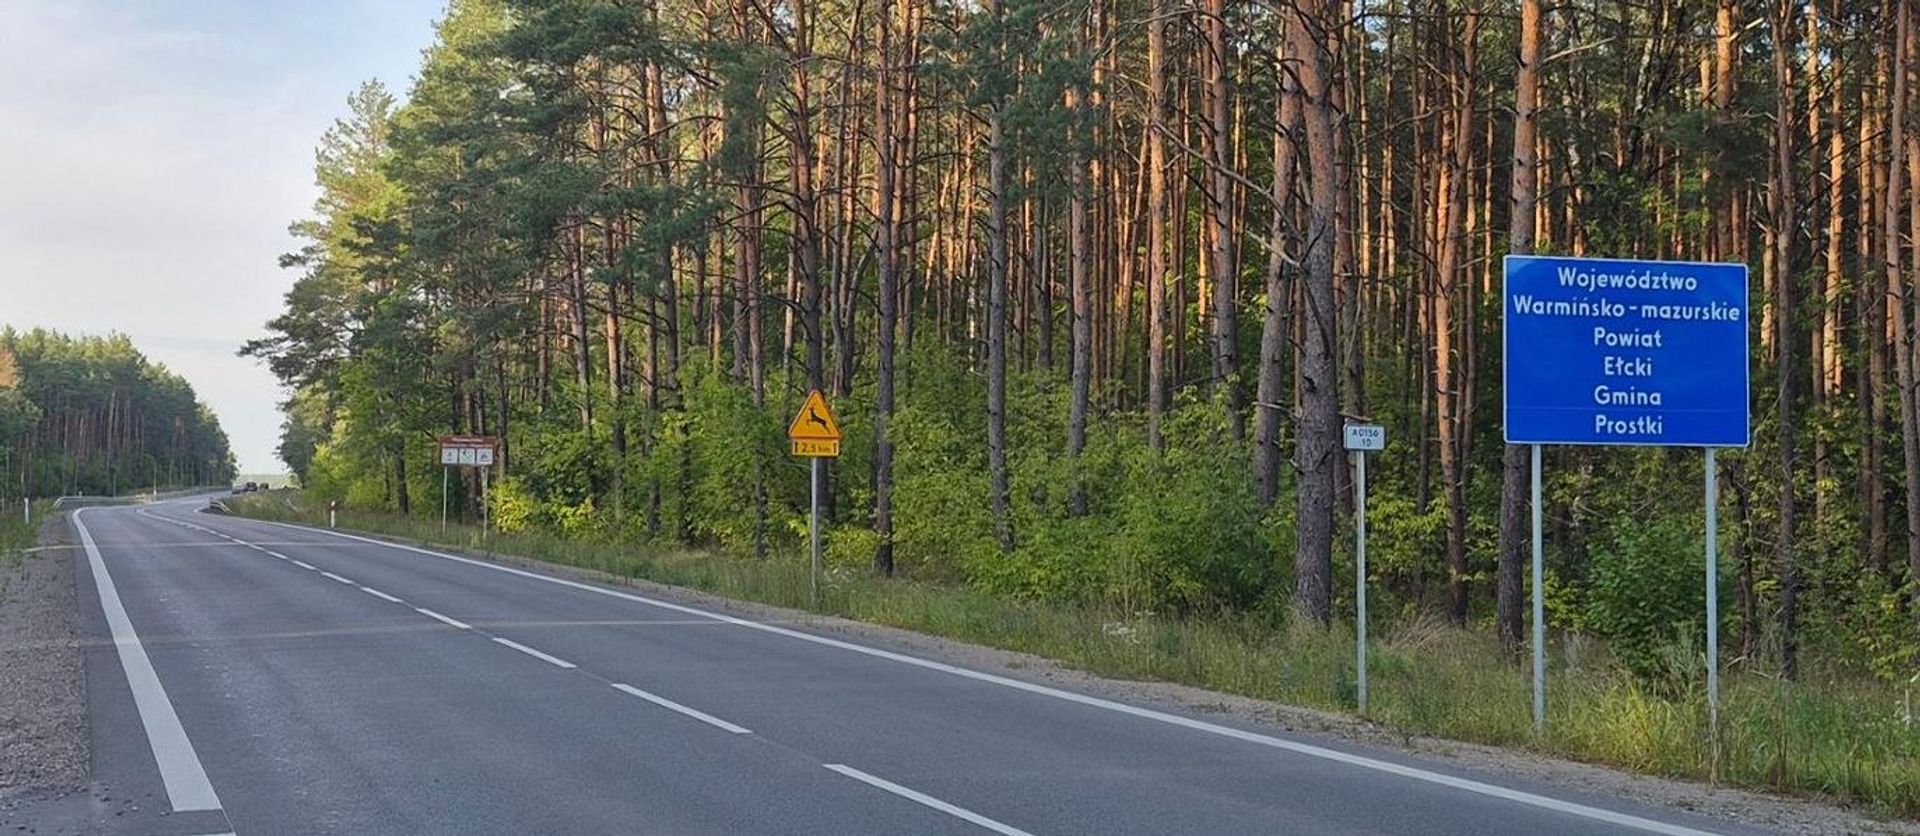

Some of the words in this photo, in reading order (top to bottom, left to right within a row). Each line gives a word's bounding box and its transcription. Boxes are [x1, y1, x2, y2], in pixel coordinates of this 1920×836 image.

[1557, 267, 1697, 291] Województwo
[1594, 327, 1663, 347] Powiat
[1604, 357, 1652, 376] Ełcki
[1594, 386, 1662, 405] Gmina
[1595, 415, 1663, 434] Prostki
